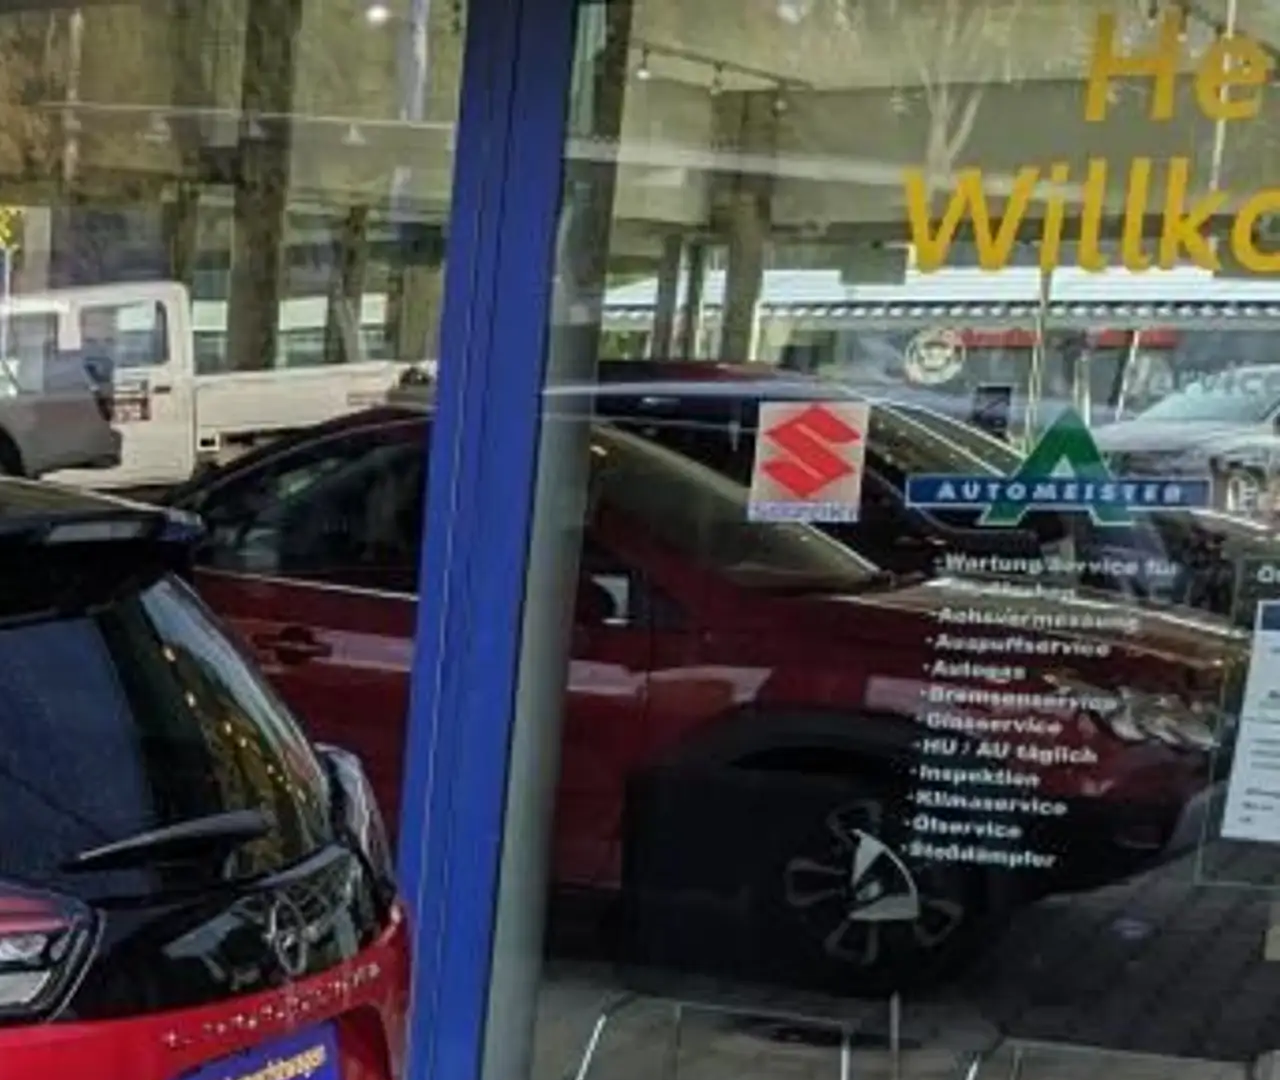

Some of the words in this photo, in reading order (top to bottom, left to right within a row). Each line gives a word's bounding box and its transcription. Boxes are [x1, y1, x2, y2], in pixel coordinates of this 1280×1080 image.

[1084, 8, 1276, 122] He
[938, 481, 1182, 503] AUTOMEISTER
[934, 633, 1110, 657] Auspuffservice
[930, 659, 1027, 683] Autogas
[922, 738, 958, 756] HU
[976, 741, 1010, 759] AU
[1016, 743, 1099, 766] täglich
[919, 764, 1041, 788] Inspektion
[915, 790, 1069, 816] Klimaservice
